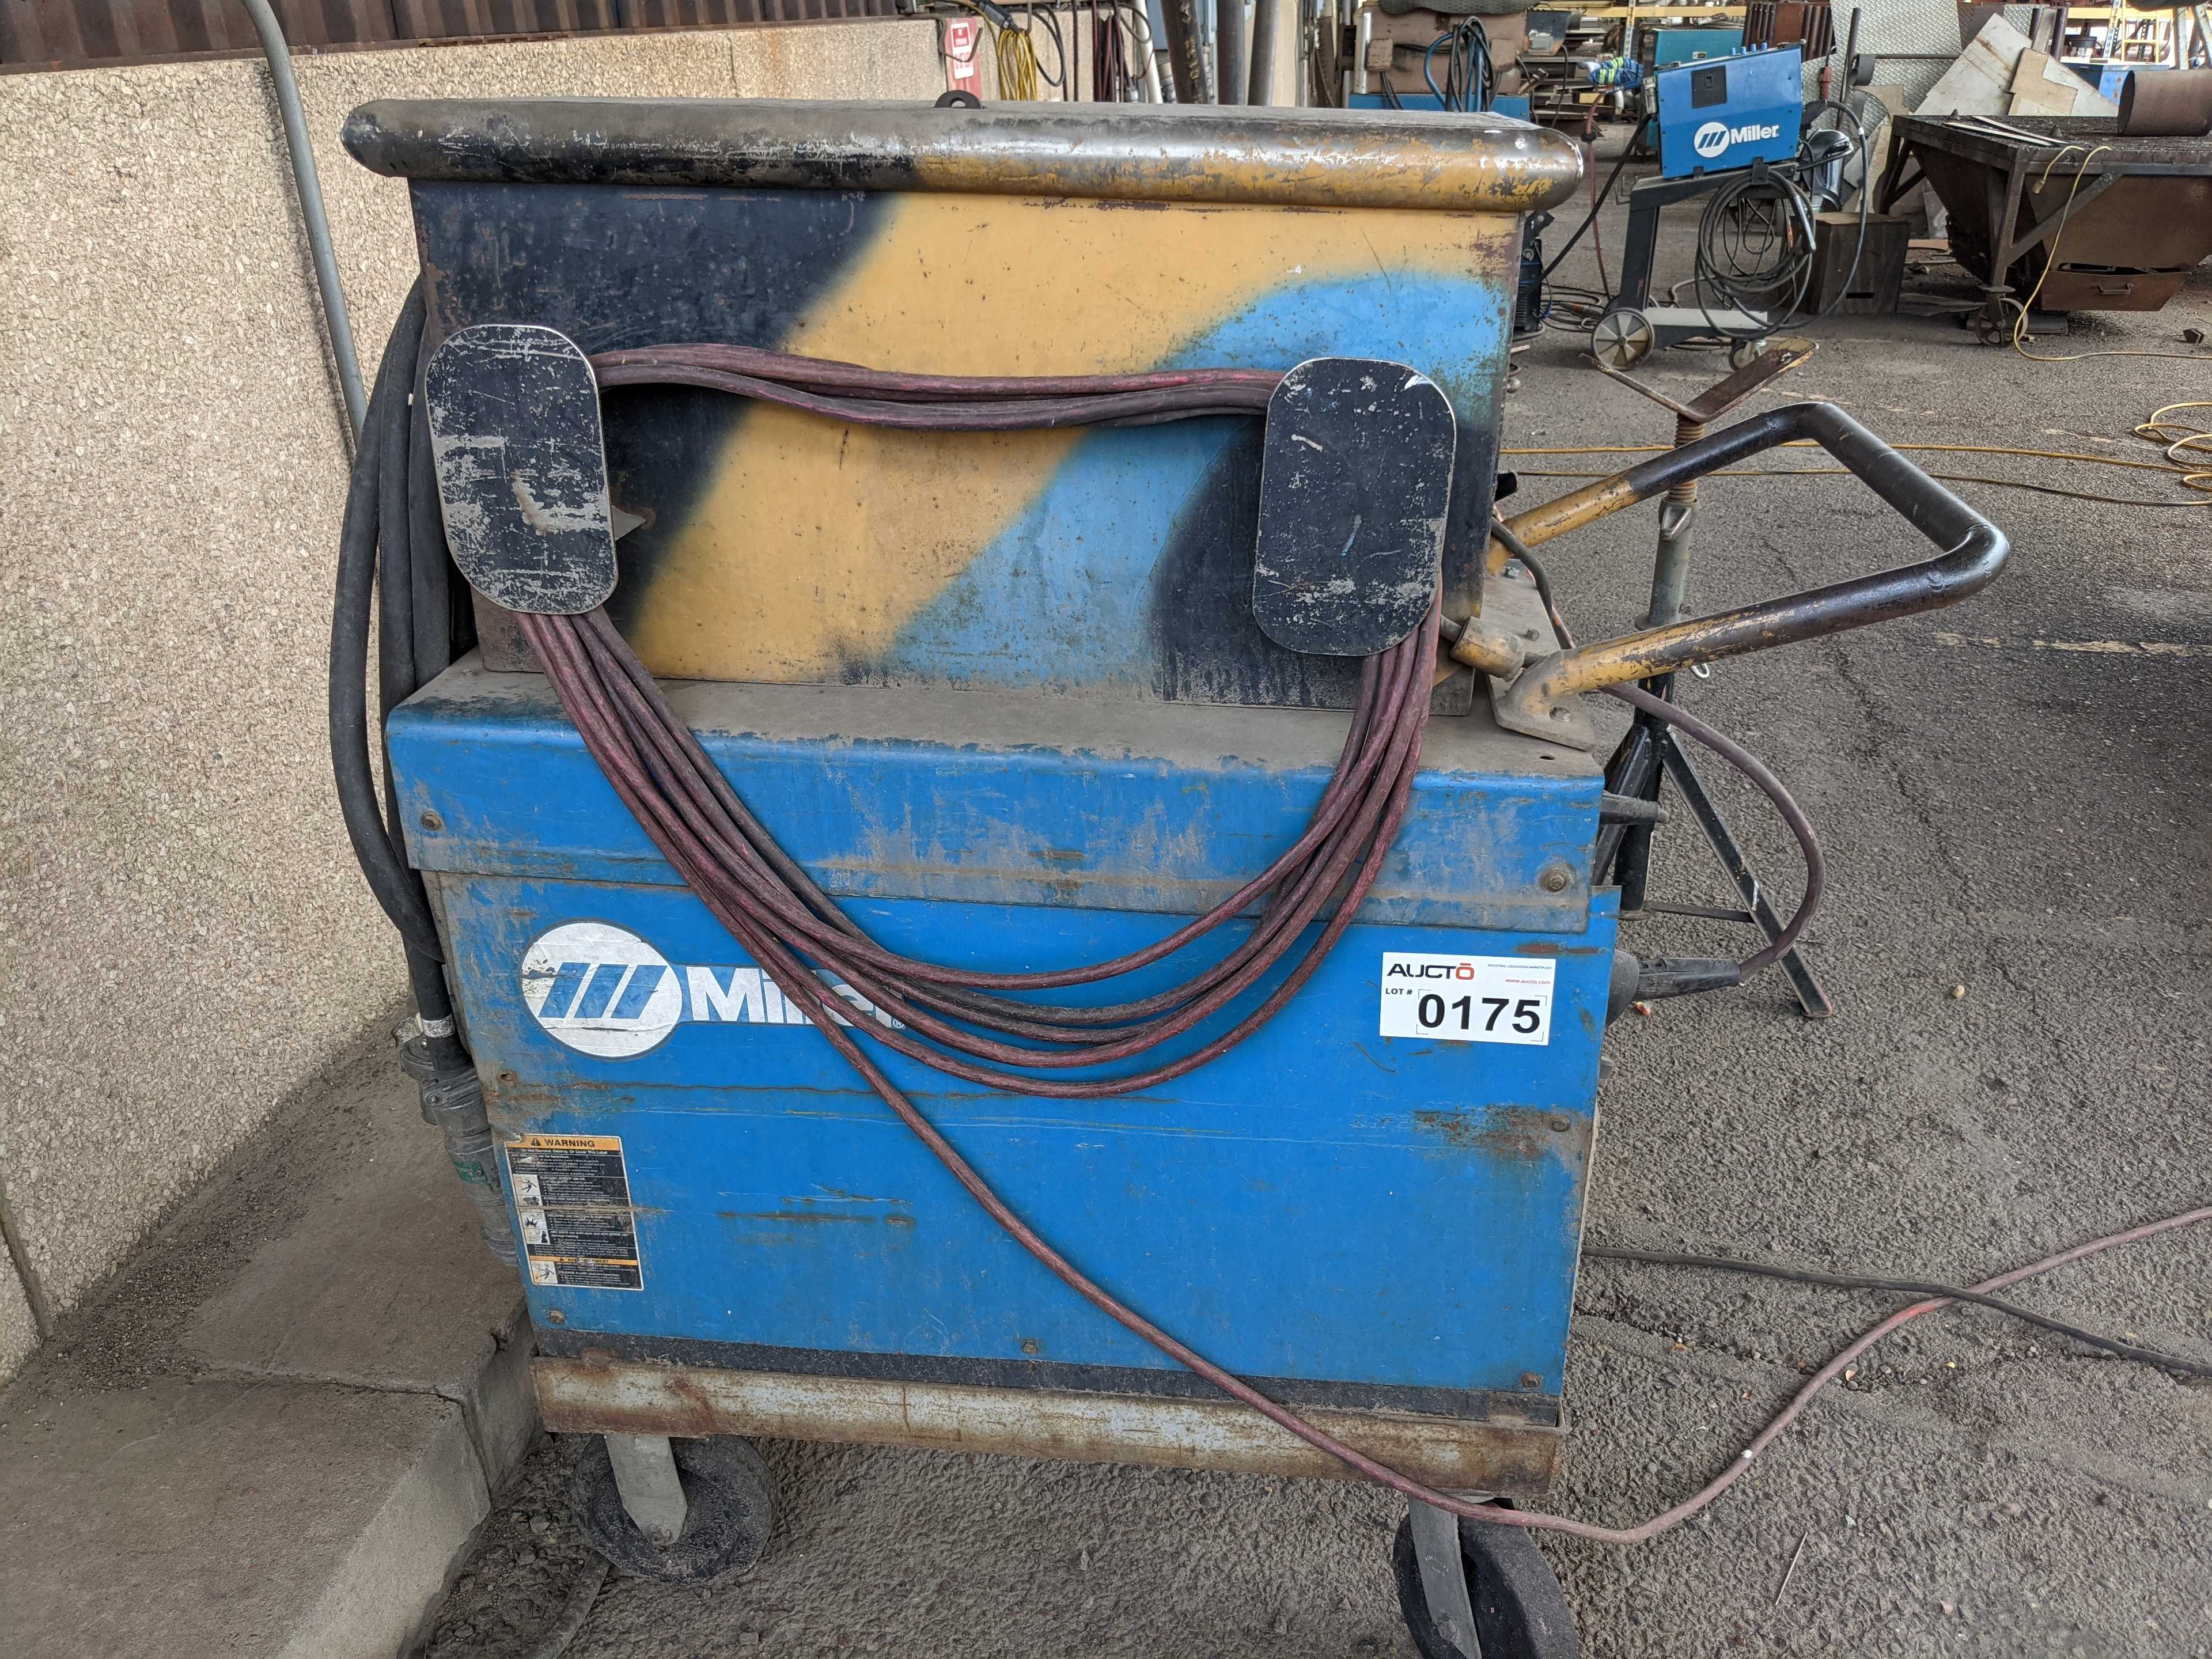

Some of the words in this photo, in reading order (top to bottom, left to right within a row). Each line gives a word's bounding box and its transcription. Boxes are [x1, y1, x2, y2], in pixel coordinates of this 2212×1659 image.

[1730, 124, 1779, 144] Miller
[1418, 994, 1540, 1033] 0175
[544, 1138, 595, 1147] WARNING
